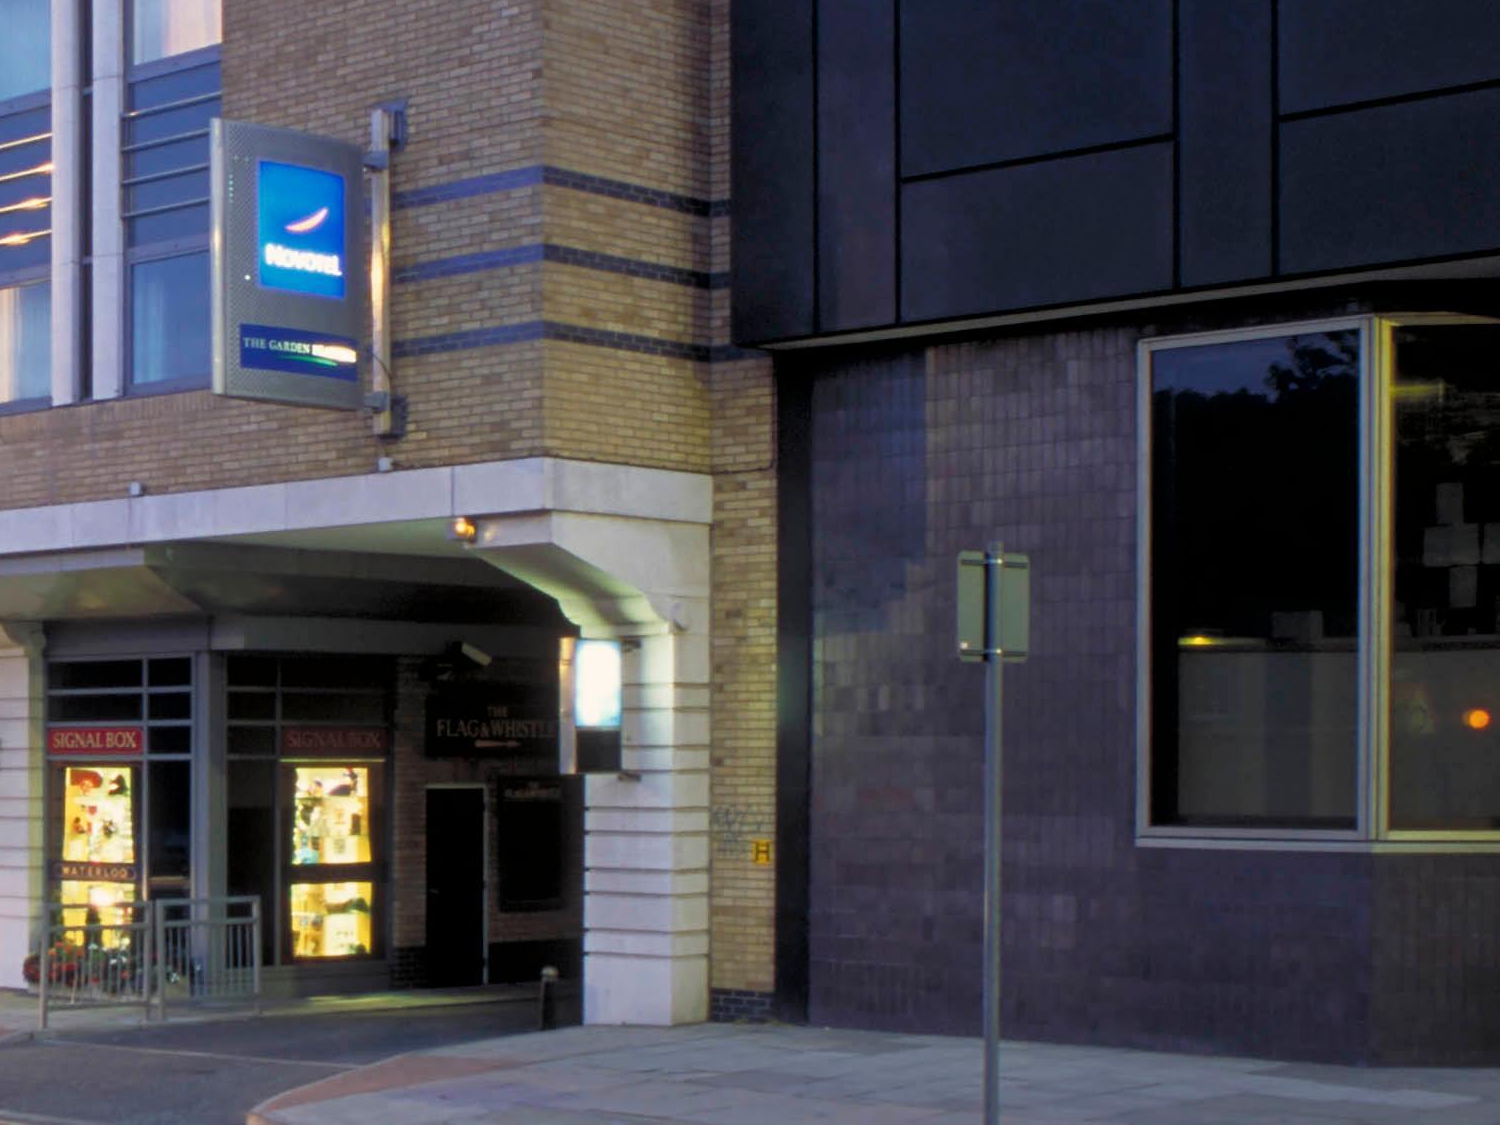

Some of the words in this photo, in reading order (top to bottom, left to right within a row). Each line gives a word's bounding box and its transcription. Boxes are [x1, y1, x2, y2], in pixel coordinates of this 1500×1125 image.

[264, 242, 342, 276] NOVOTEL
[243, 337, 267, 350] THE
[269, 339, 310, 354] GARDEN
[52, 731, 103, 748] SIGNAL
[106, 731, 137, 748] BOX
[287, 730, 344, 748] SIGNAL
[755, 843, 770, 862] H
[62, 866, 128, 879] WATERLOO
